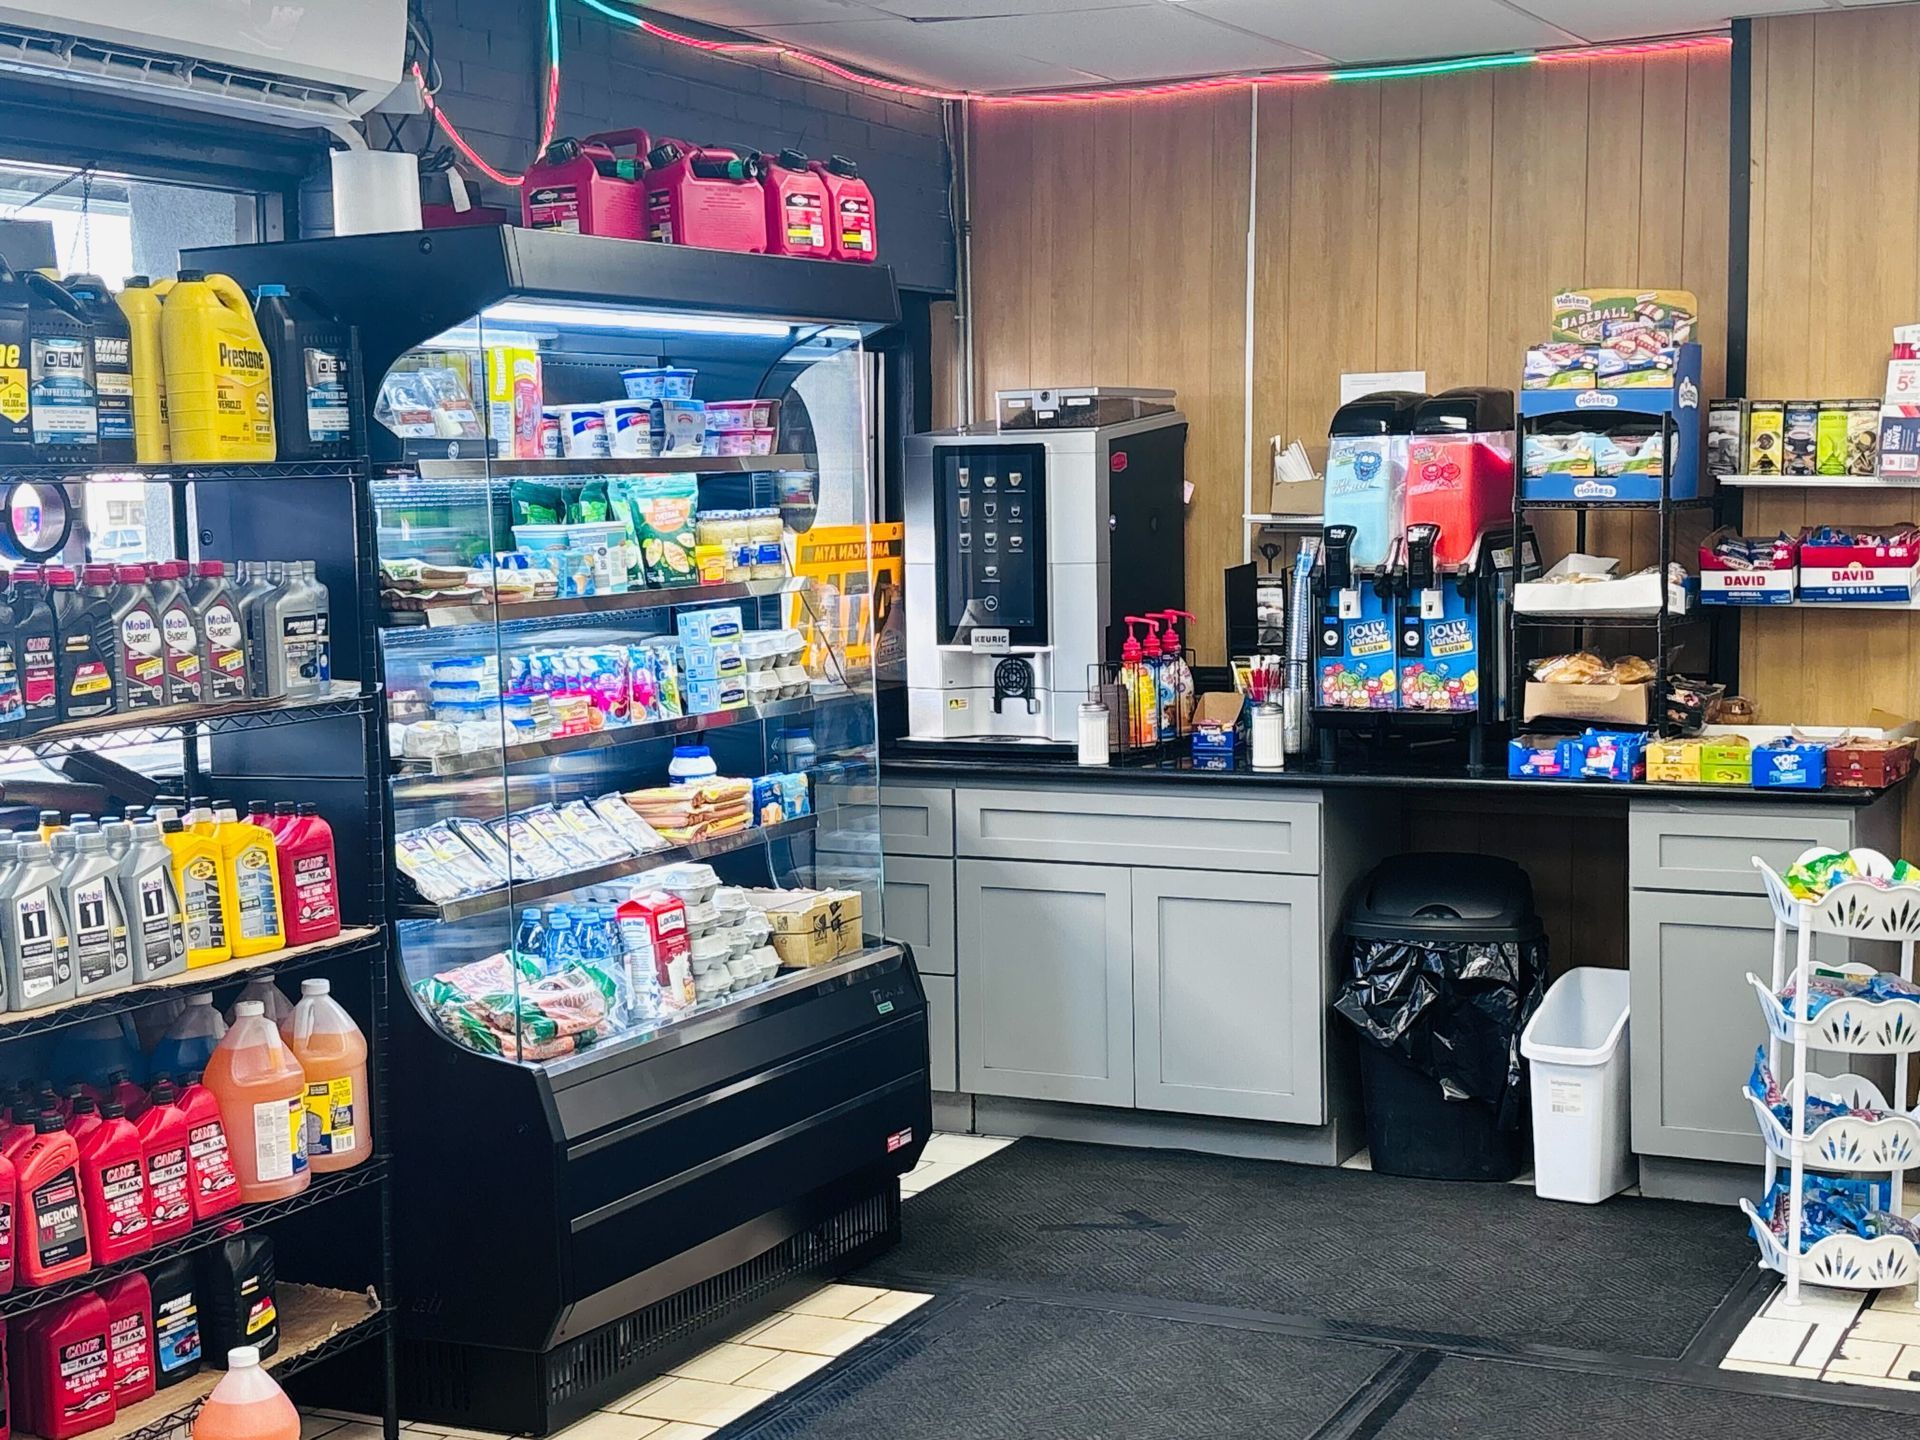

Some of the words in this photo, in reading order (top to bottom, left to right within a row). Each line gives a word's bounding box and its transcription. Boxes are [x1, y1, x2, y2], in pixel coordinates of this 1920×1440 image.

[1556, 294, 1590, 306] Hostess
[1561, 306, 1629, 330] BASEBALL
[45, 352, 83, 367] OEM
[218, 343, 265, 370] Prestone
[319, 359, 347, 372] OEM
[1579, 395, 1615, 405] Hostess
[1891, 424, 1902, 450] SAVE
[1577, 485, 1614, 495] Hostess
[1724, 575, 1766, 586] DAVID
[1832, 570, 1874, 581] DAVID
[1827, 586, 1884, 595] ORIGINAL
[125, 619, 151, 631] Mobil
[165, 618, 188, 630] Mobil
[208, 614, 232, 625] Mobil
[166, 630, 190, 642] Super
[209, 626, 233, 638] Super
[1349, 621, 1386, 640] JOLLY
[1429, 621, 1468, 640] JOLLY
[126, 631, 151, 645] Super
[974, 635, 1007, 643] KEURIG
[1351, 633, 1390, 647] rancher
[1432, 633, 1472, 647] rancher
[1358, 644, 1384, 654] SLUSH
[1439, 644, 1465, 654] SLUSH
[142, 879, 163, 890] Mobil
[78, 889, 103, 902] Mobil
[20, 900, 46, 912] Mobil
[660, 910, 683, 927] Lactaid
[117, 1178, 141, 1192] MAX
[39, 1203, 78, 1229] MERCON
[158, 1292, 192, 1314] PRIME
[119, 1328, 144, 1344] MAX
[77, 1353, 105, 1368] MAX
[65, 1378, 80, 1390] SAE
[80, 1369, 107, 1384] 10W-40
